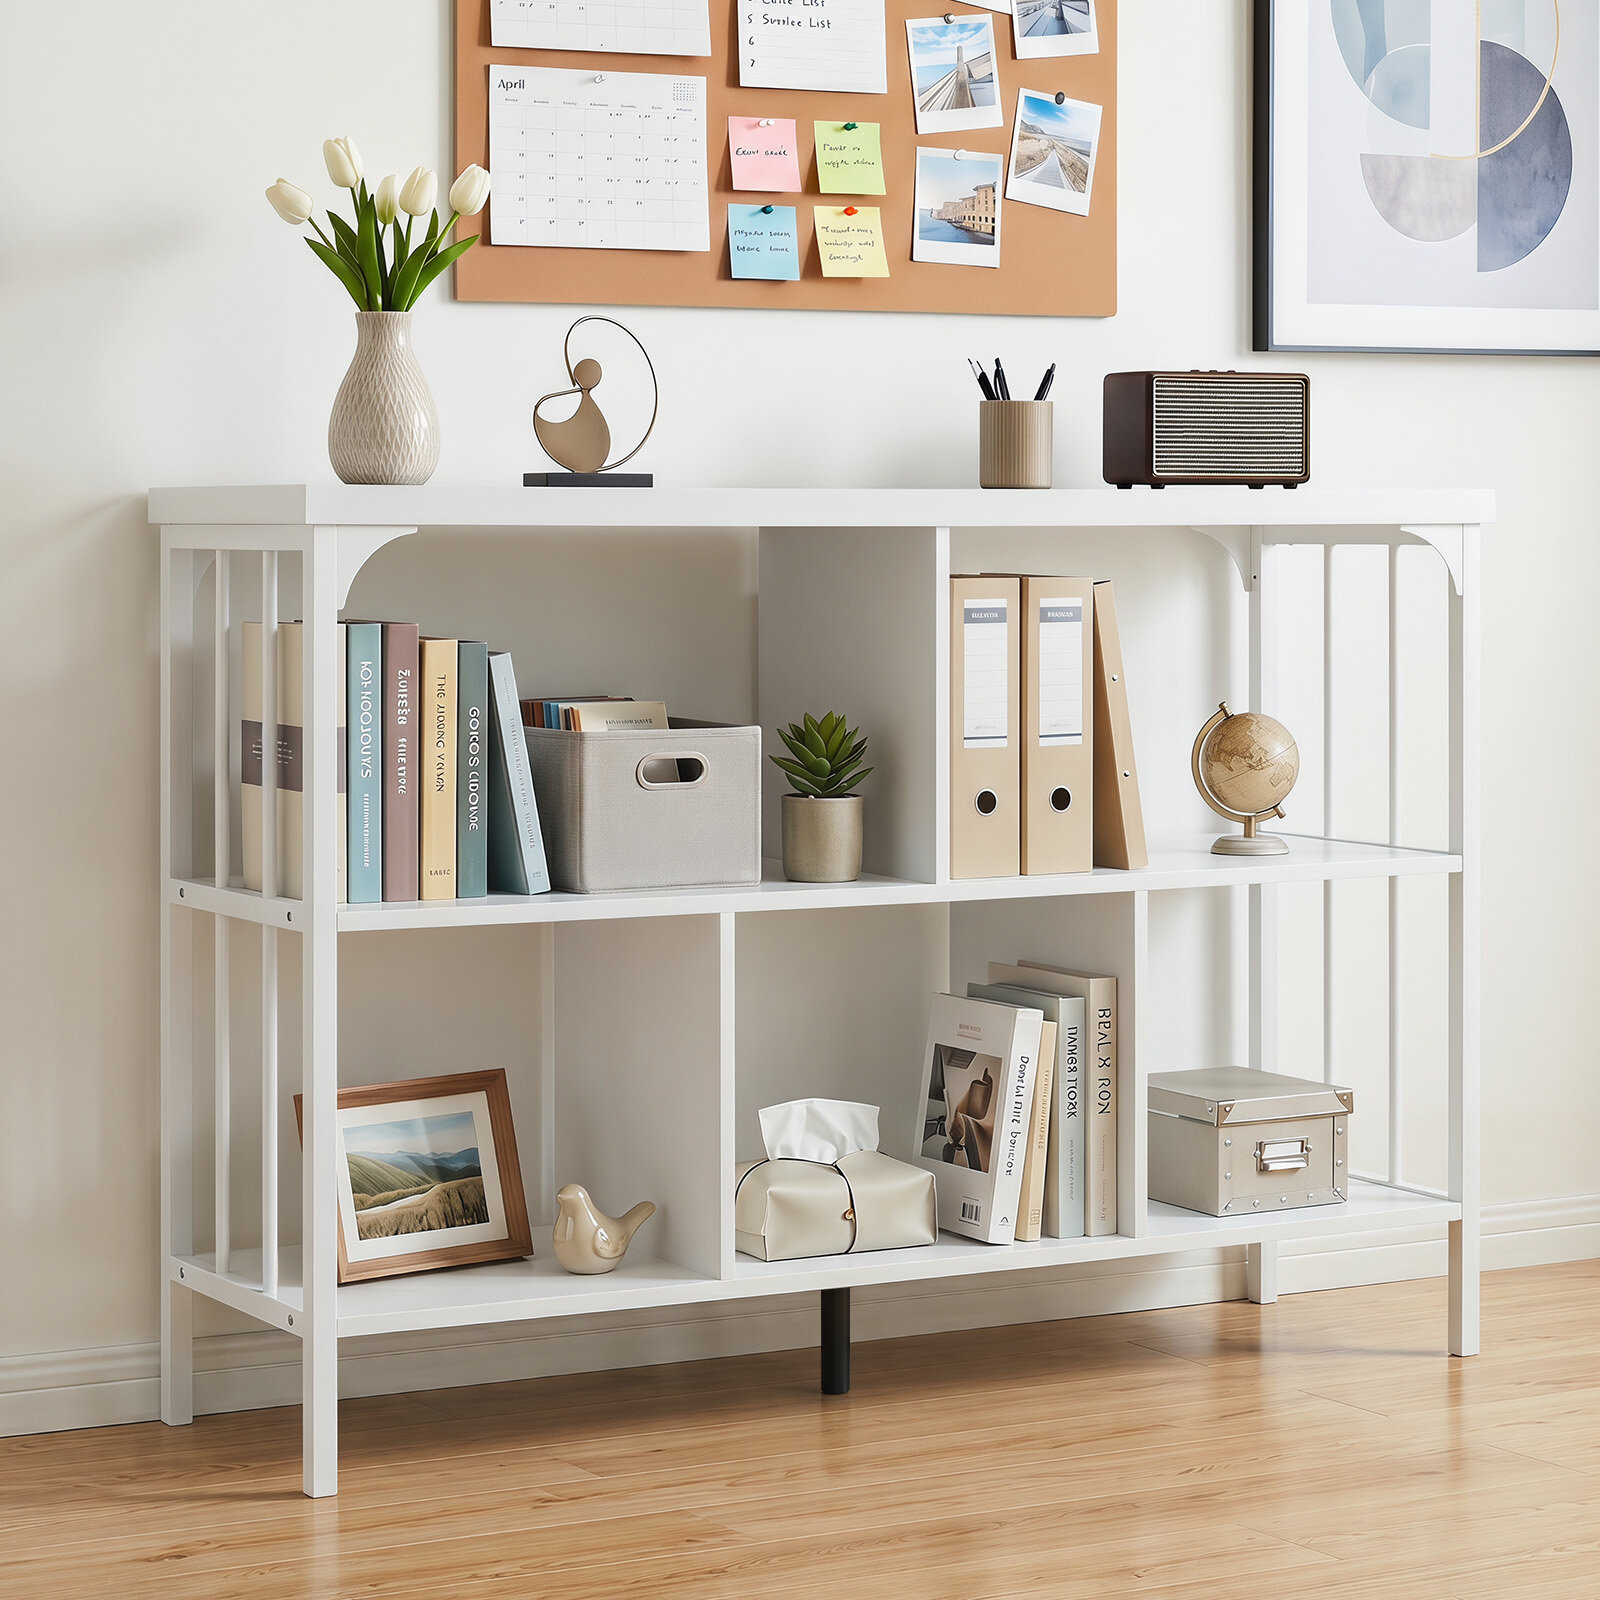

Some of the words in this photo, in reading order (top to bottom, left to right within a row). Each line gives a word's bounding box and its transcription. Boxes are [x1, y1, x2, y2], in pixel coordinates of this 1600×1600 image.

[809, 17, 831, 28] List
[748, 36, 755, 46] 6
[750, 58, 756, 68] 7
[497, 79, 525, 91] April
